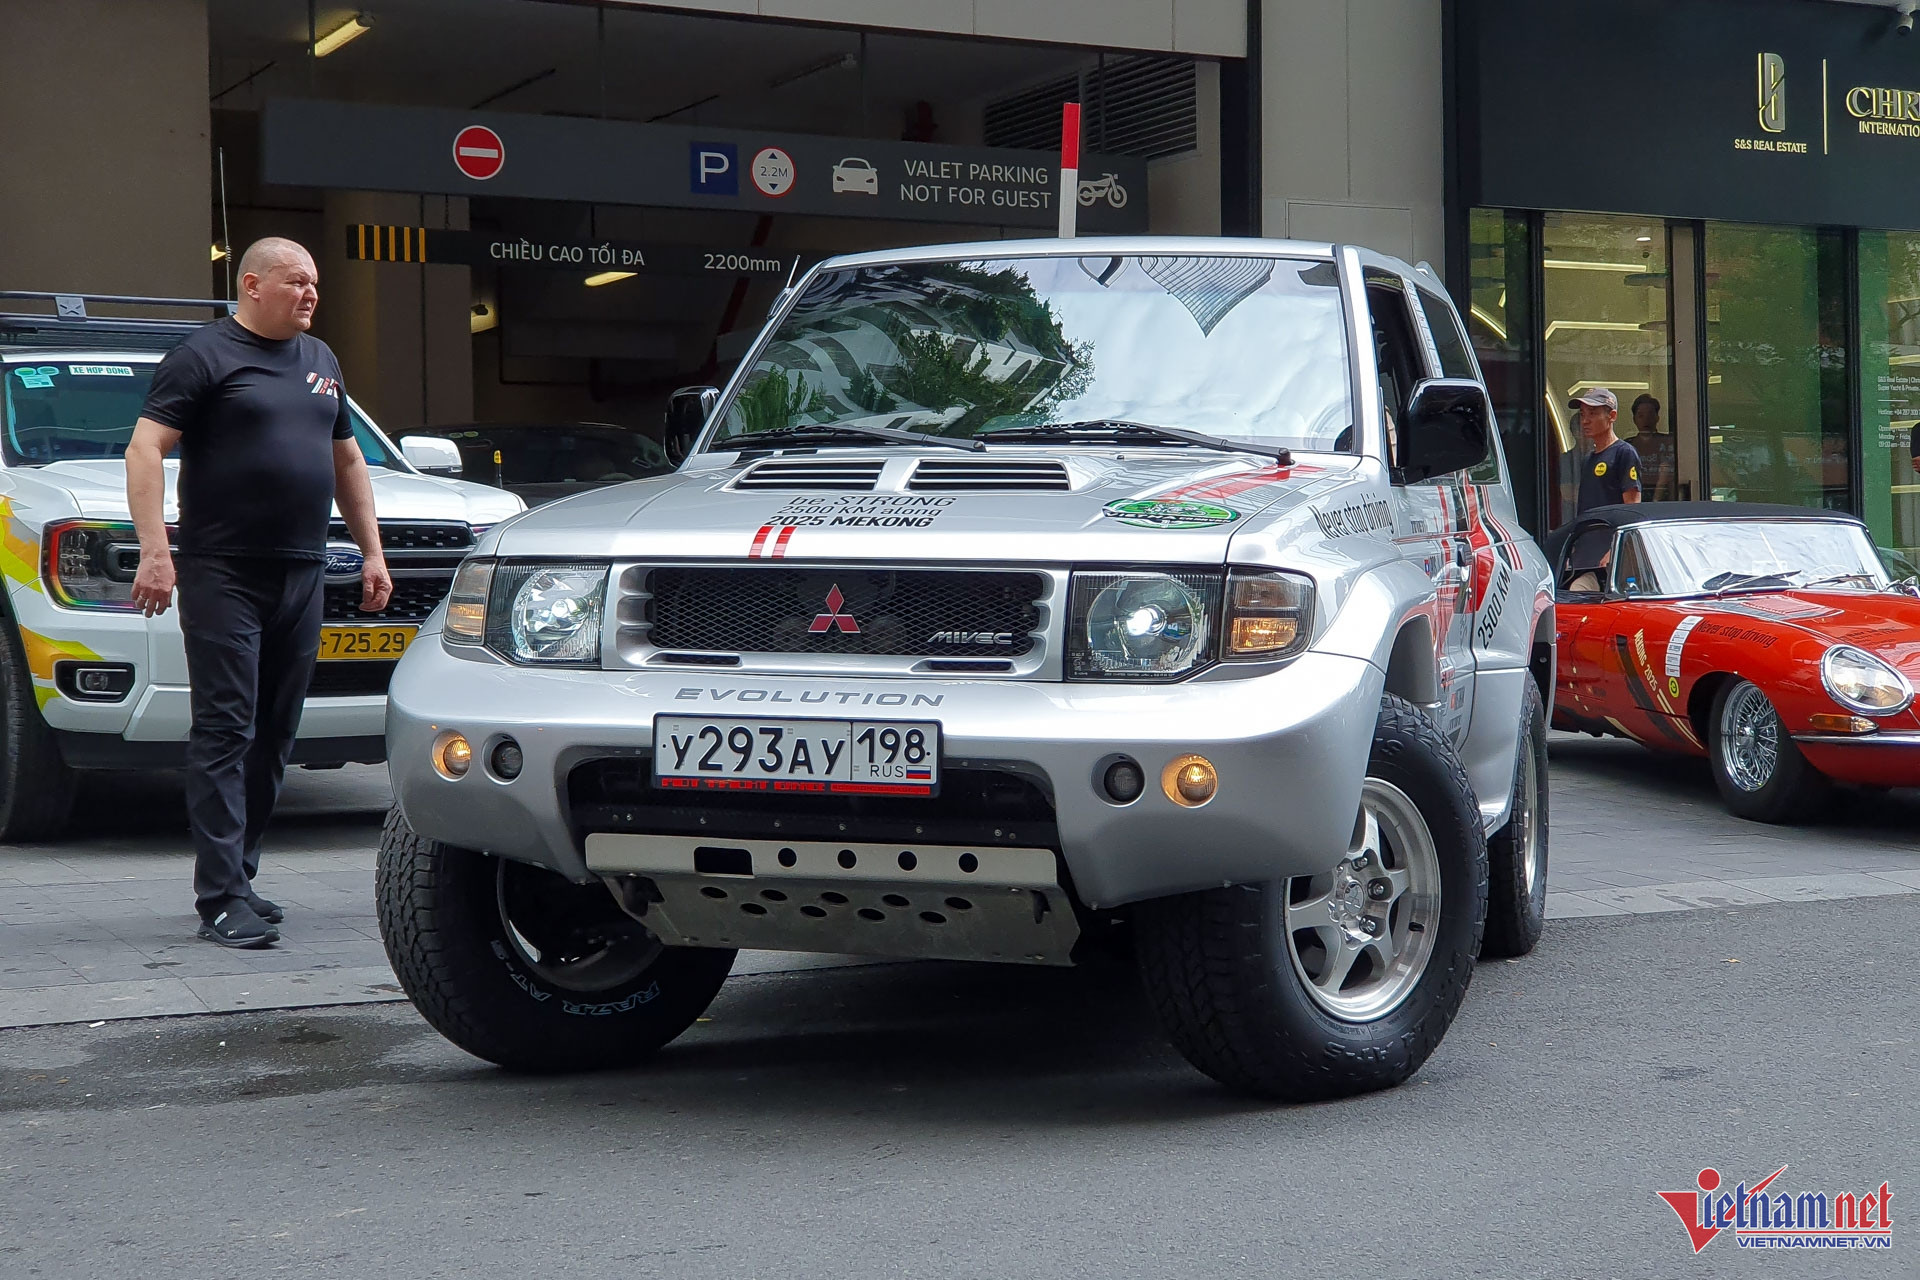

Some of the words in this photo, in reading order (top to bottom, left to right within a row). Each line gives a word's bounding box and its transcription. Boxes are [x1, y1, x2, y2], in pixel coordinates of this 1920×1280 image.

[1846, 86, 1920, 121] CHR
[1734, 138, 1752, 150] S&S
[1753, 140, 1775, 151] REAL
[1777, 141, 1807, 153] ESTATE
[700, 151, 729, 184] P
[760, 166, 788, 178] 2.2M
[904, 159, 963, 179] VALET
[969, 163, 1048, 184] PARKING
[900, 184, 942, 203] NOT
[949, 187, 985, 205] FOR
[991, 189, 1051, 209] GUEST
[490, 237, 542, 261] CHIỀU
[549, 245, 583, 262] CAO
[588, 242, 616, 264] TỐI
[622, 249, 645, 266] ĐA
[704, 253, 781, 272] 2200mm
[72, 366, 84, 374] XE
[777, 505, 834, 514] 2500
[838, 506, 877, 514] KM
[880, 506, 942, 517] along
[789, 496, 826, 505] be
[834, 496, 956, 507] STRONG
[764, 515, 828, 526] 2025
[829, 516, 934, 527] MEKONG
[1307, 504, 1352, 540] Never
[1343, 500, 1374, 537] stop
[1360, 492, 1394, 534] driving
[1477, 592, 1502, 650] 2500
[1496, 563, 1511, 602] KM
[927, 631, 1012, 645] MIVEC
[1695, 620, 1724, 635] Never
[1720, 625, 1743, 640] stop
[1740, 628, 1779, 648] driving
[1644, 664, 1658, 691] 2025
[674, 687, 945, 707] EVOLUTION
[856, 727, 925, 764] 198
[870, 764, 904, 778] RUS
[562, 980, 660, 1015] RAZR
